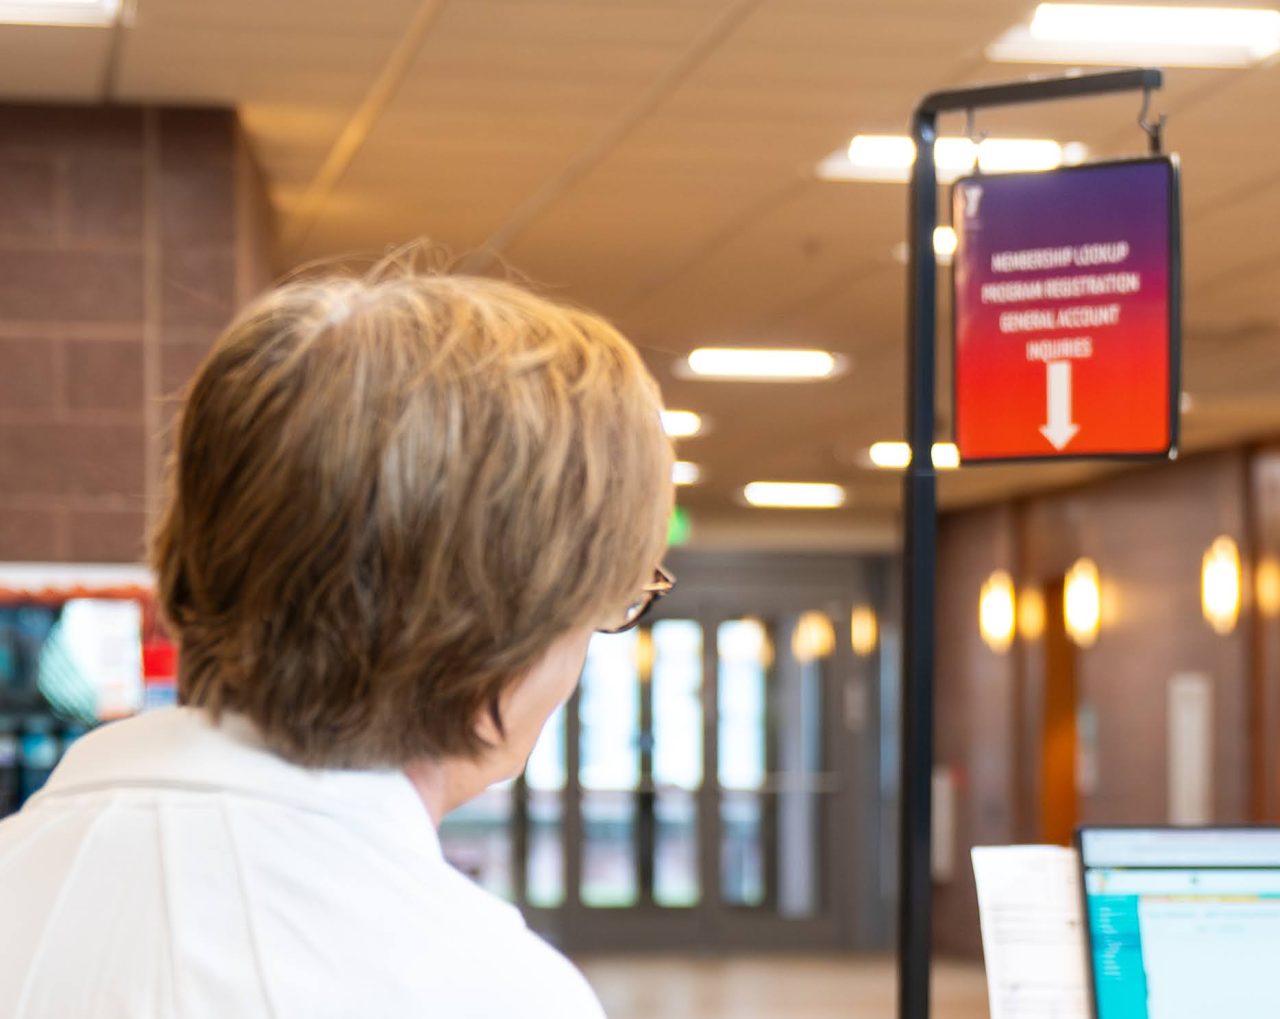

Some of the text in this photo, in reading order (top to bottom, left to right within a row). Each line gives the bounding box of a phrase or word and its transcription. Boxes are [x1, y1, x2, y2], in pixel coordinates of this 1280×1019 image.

[991, 241, 1130, 273] MEMBERSHIP LOOKUP
[981, 272, 1140, 303] PROGRAM REGISTRATION
[1000, 304, 1120, 333] GENERAL ACCOUNT
[1026, 337, 1093, 361] INQUIRIES
